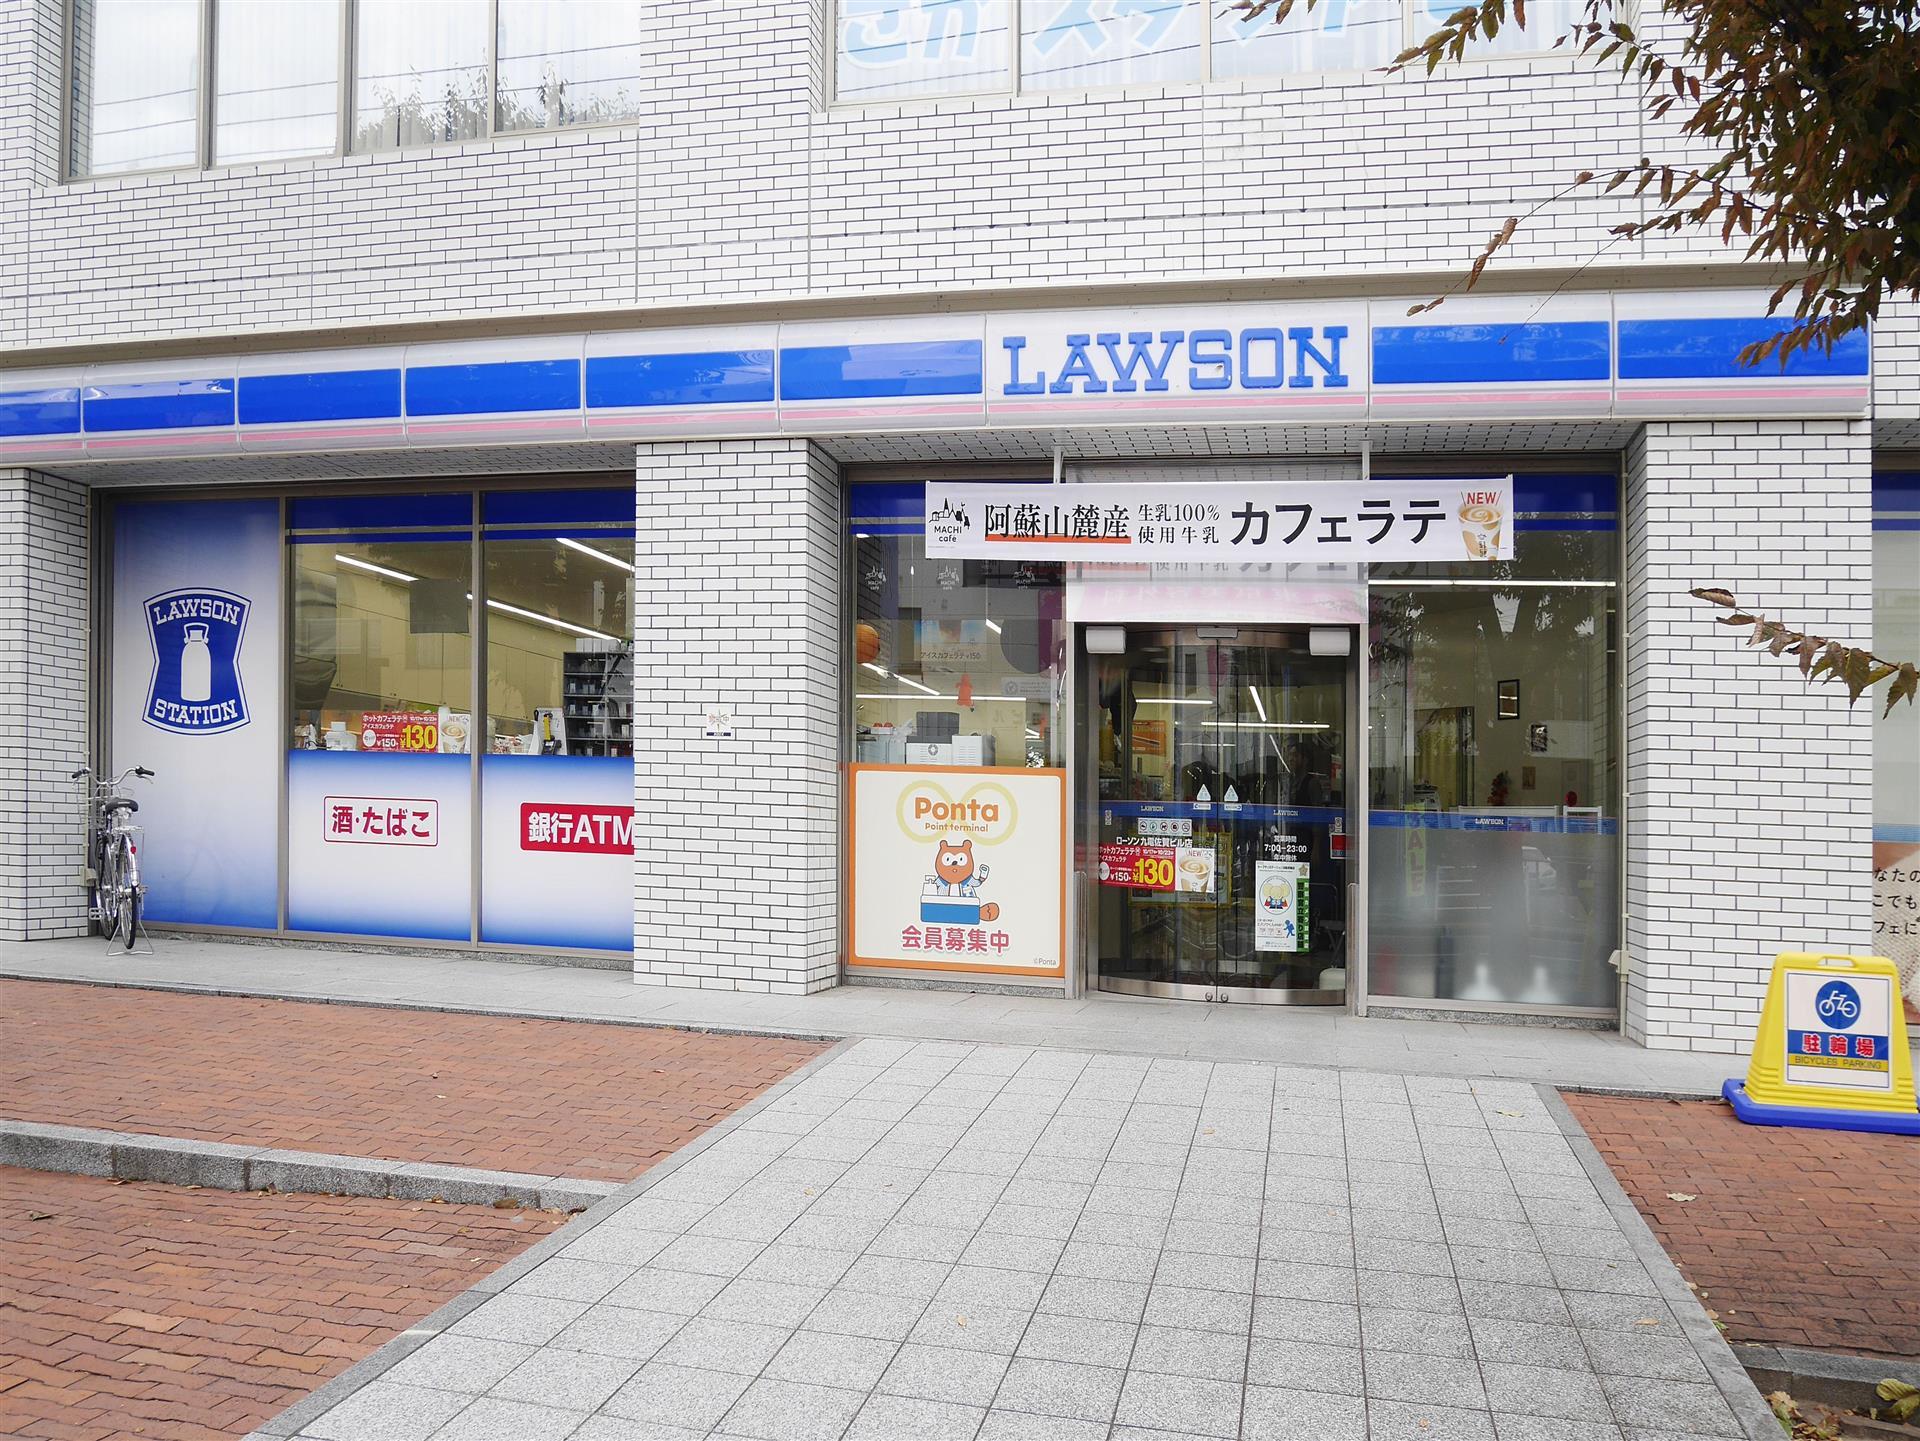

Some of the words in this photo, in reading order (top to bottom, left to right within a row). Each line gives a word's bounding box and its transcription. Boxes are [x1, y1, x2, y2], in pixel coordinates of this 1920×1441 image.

[1002, 326, 1348, 395] LAWSON
[1467, 491, 1497, 505] NEW
[934, 525, 962, 534] MACHI
[984, 503, 1130, 539] 阿蘇山麓産
[1230, 500, 1446, 545] カフェラテ
[1138, 525, 1220, 544] 使用牛乳
[153, 598, 241, 626] LAWSON
[153, 697, 238, 725] STATION
[400, 724, 437, 749] ¥130
[914, 797, 999, 822] Ponta
[1475, 817, 1504, 825] LAWSON
[528, 811, 635, 846] 銀行ATM
[924, 822, 948, 831] Point
[950, 823, 989, 832] terminal
[1110, 872, 1129, 881] ¥150
[1132, 858, 1174, 885] ¥130
[902, 925, 1009, 952] 会員募集中
[1874, 921, 1918, 935] フェに
[1803, 1034, 1874, 1057] 駐輪場
[1795, 1055, 1837, 1066] BICYCLES
[1843, 1059, 1881, 1069] PARKING
